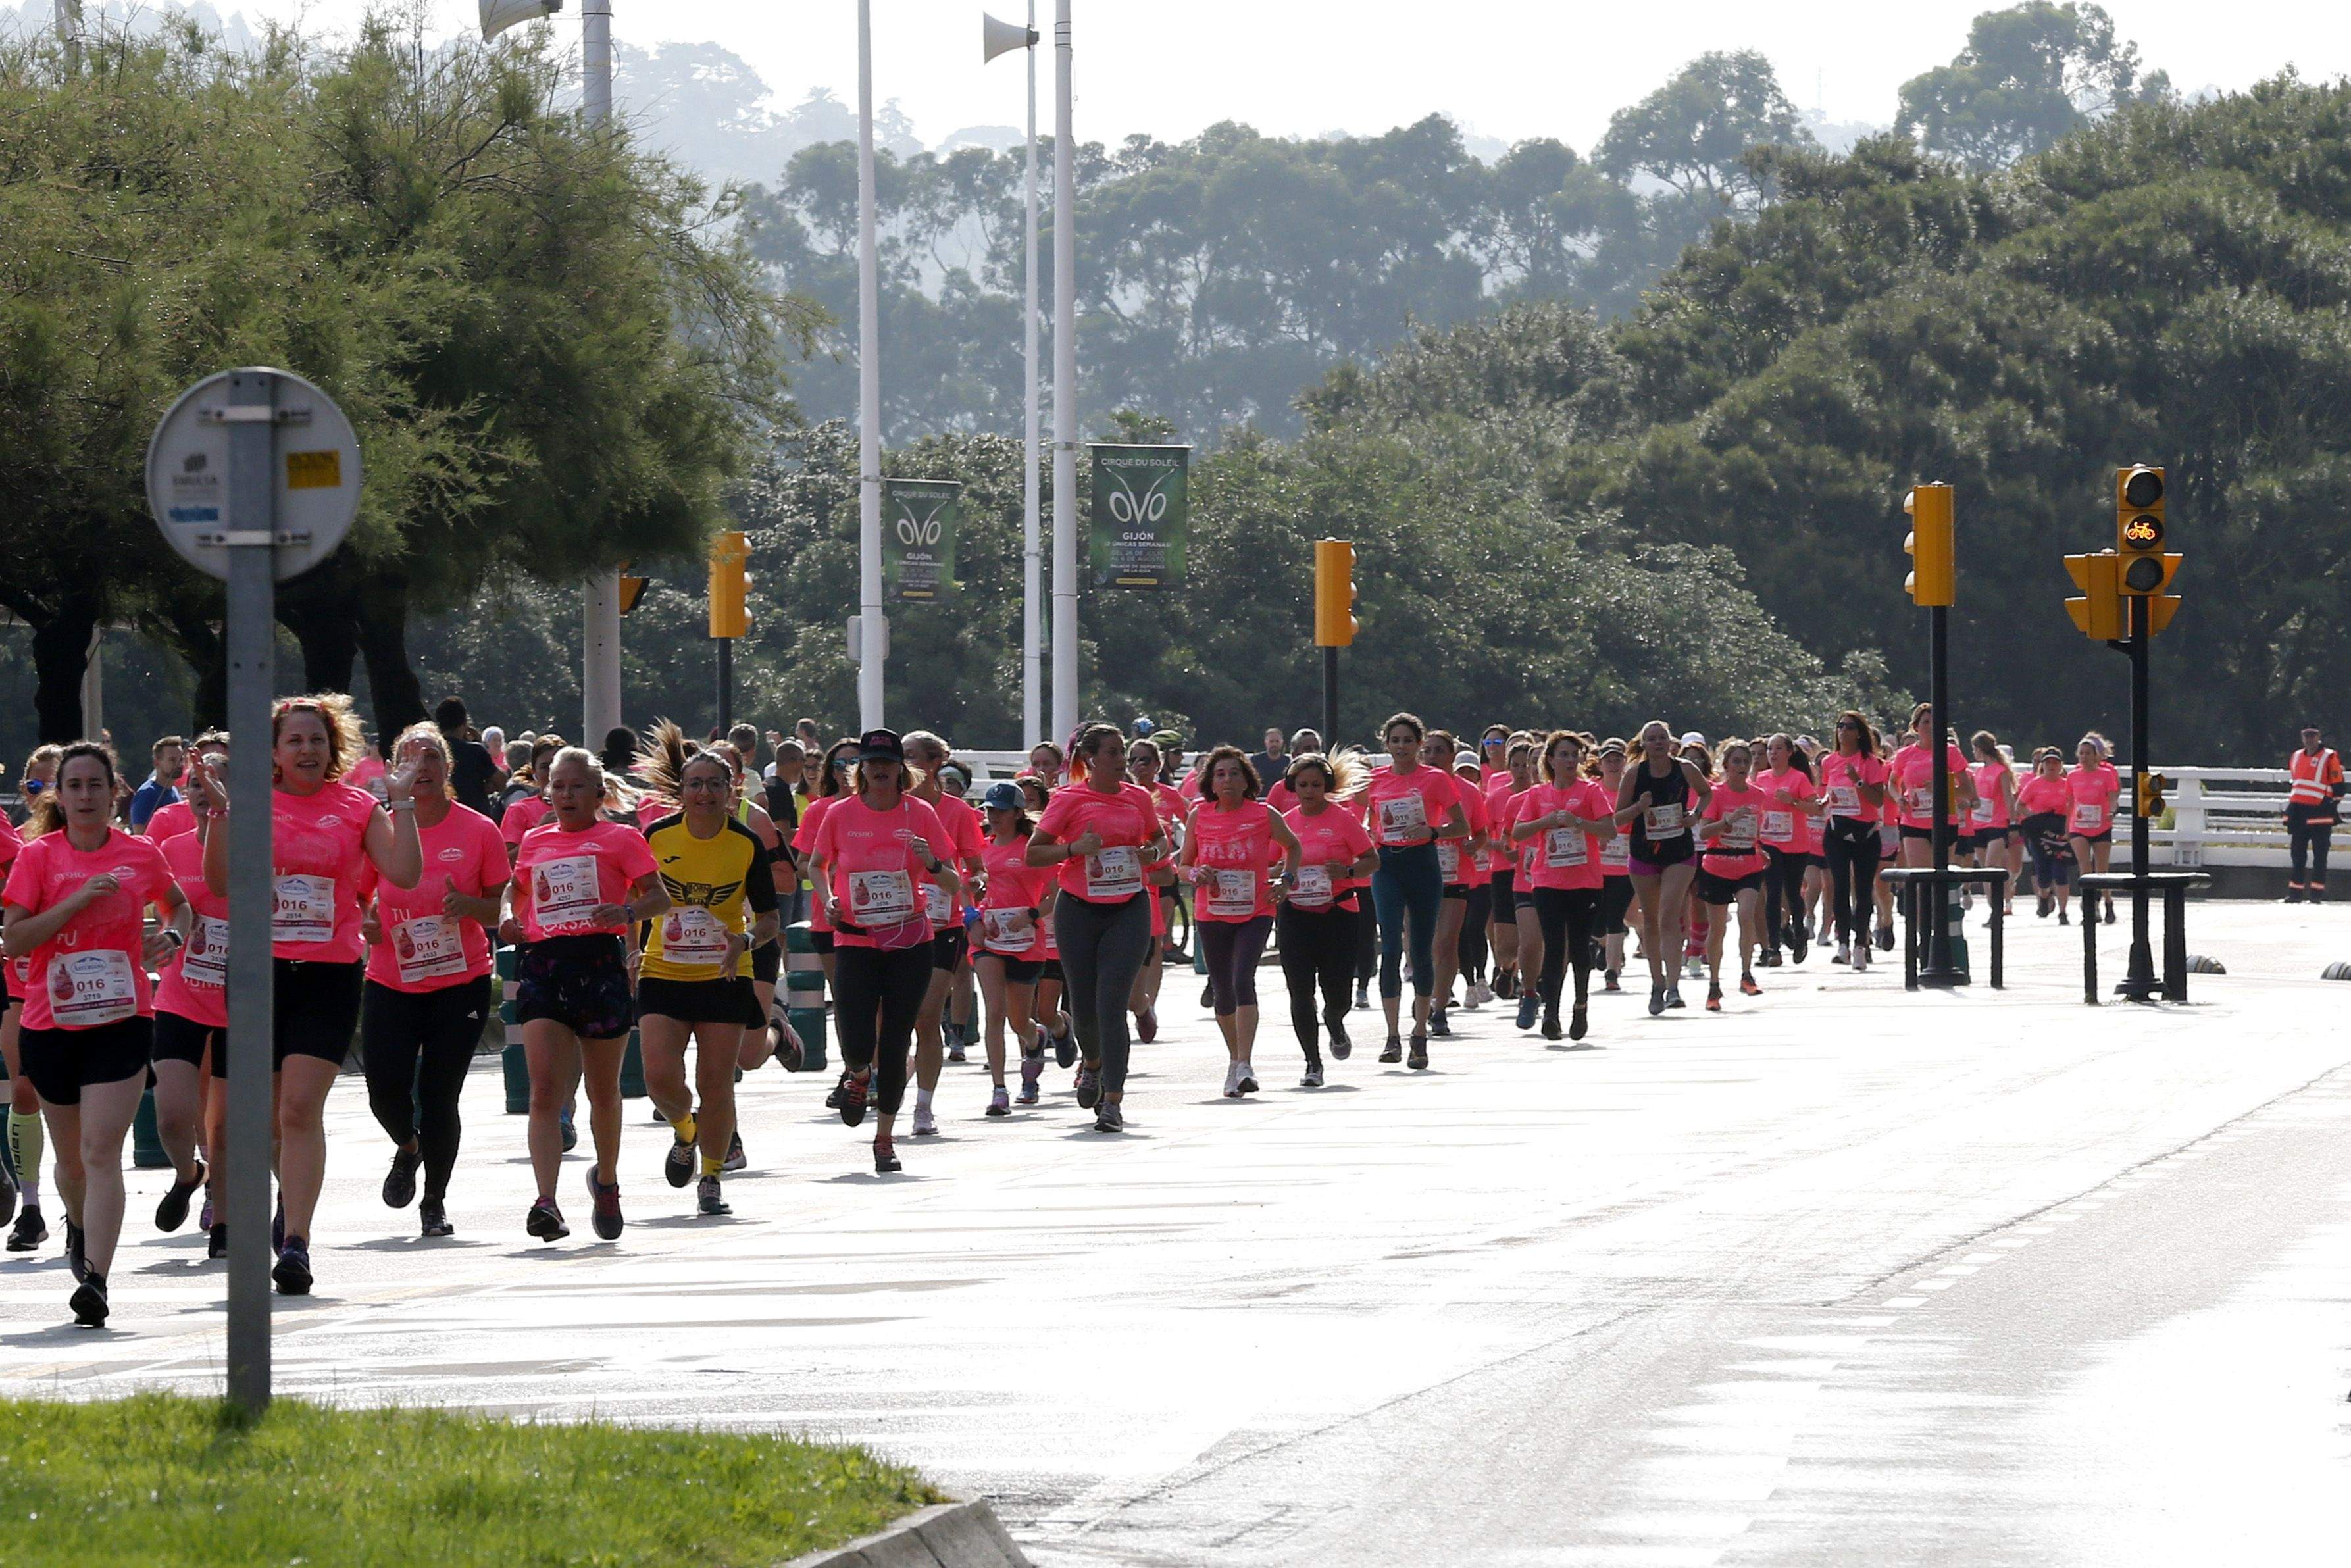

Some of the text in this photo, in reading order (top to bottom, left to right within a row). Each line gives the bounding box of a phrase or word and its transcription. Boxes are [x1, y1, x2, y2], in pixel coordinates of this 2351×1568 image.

[1101, 458, 1134, 468] CIRQUE
[892, 490, 917, 499] CIRQUE
[1123, 531, 1154, 540] GIJÓN
[906, 552, 932, 561] GIJÓN
[1105, 865, 1124, 874] 016
[552, 882, 574, 894] 016
[687, 882, 711, 893] BORN
[872, 891, 892, 900] 016
[282, 899, 307, 910] 016
[391, 909, 411, 921] TU
[684, 928, 707, 937] 016
[57, 930, 78, 946] TU
[417, 939, 440, 951] 016
[76, 978, 105, 992] 016
